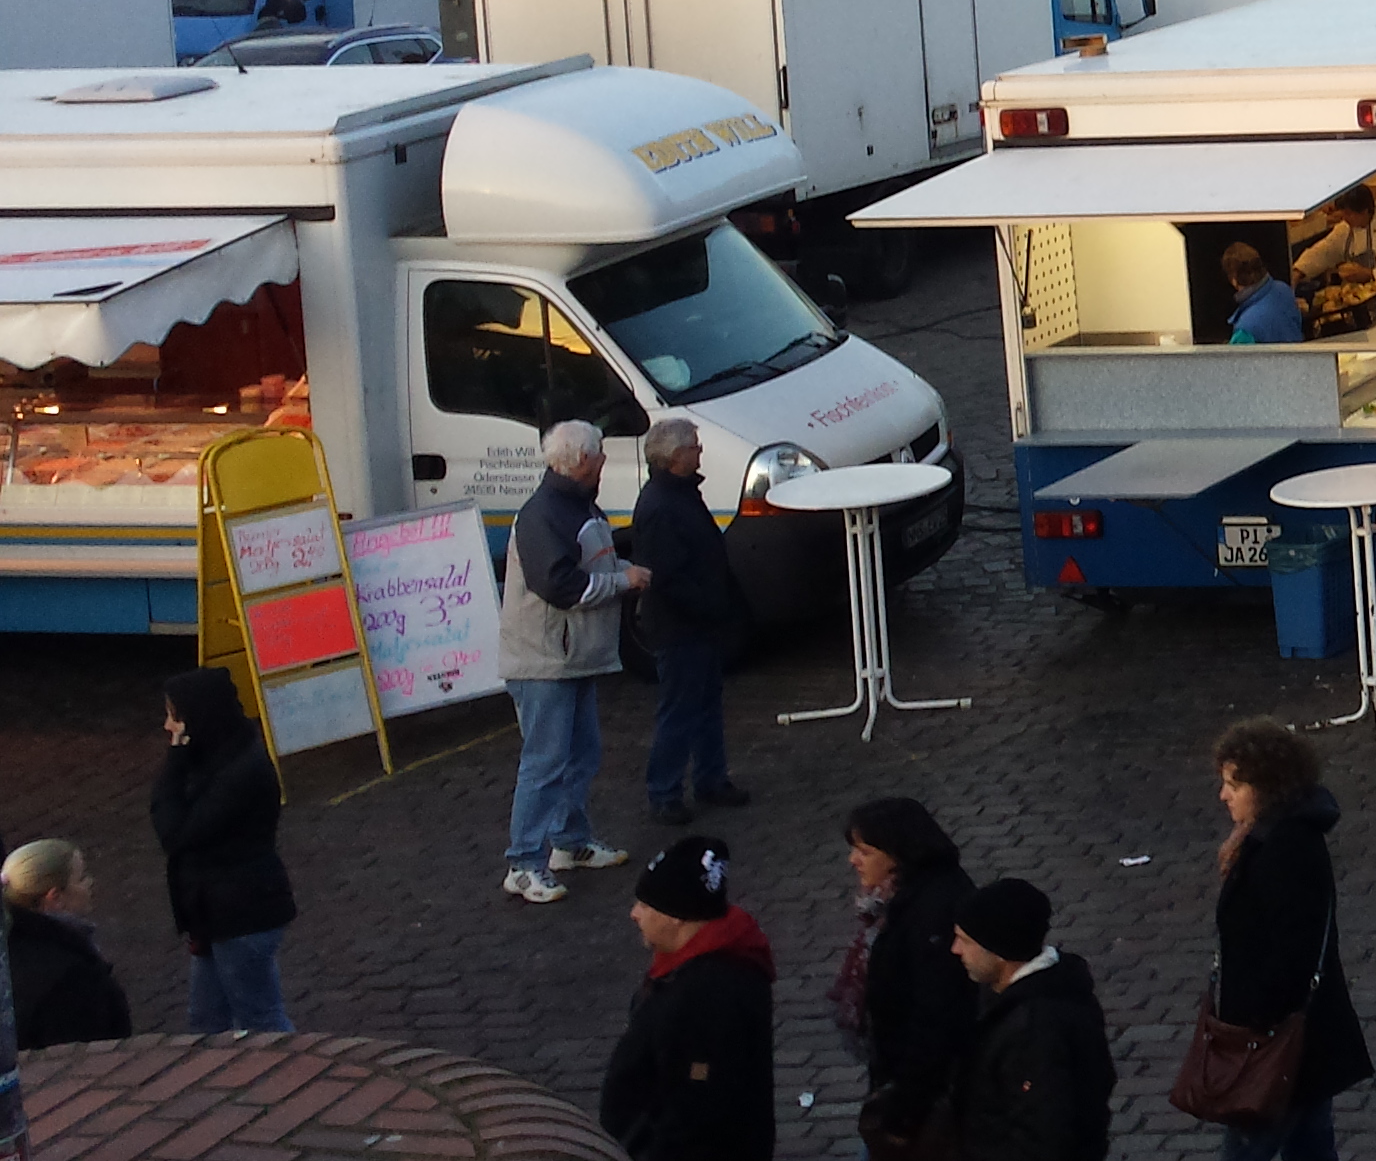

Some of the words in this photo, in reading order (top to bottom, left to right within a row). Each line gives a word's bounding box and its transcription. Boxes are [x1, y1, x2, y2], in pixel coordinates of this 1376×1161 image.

[703, 113, 779, 148] WILL
[487, 446, 513, 457] Edith
[515, 446, 537, 457] Will
[1240, 529, 1260, 545] PI
[1224, 547, 1246, 564] JA
[356, 559, 471, 605] Krabbensalat
[363, 609, 406, 637] 200g
